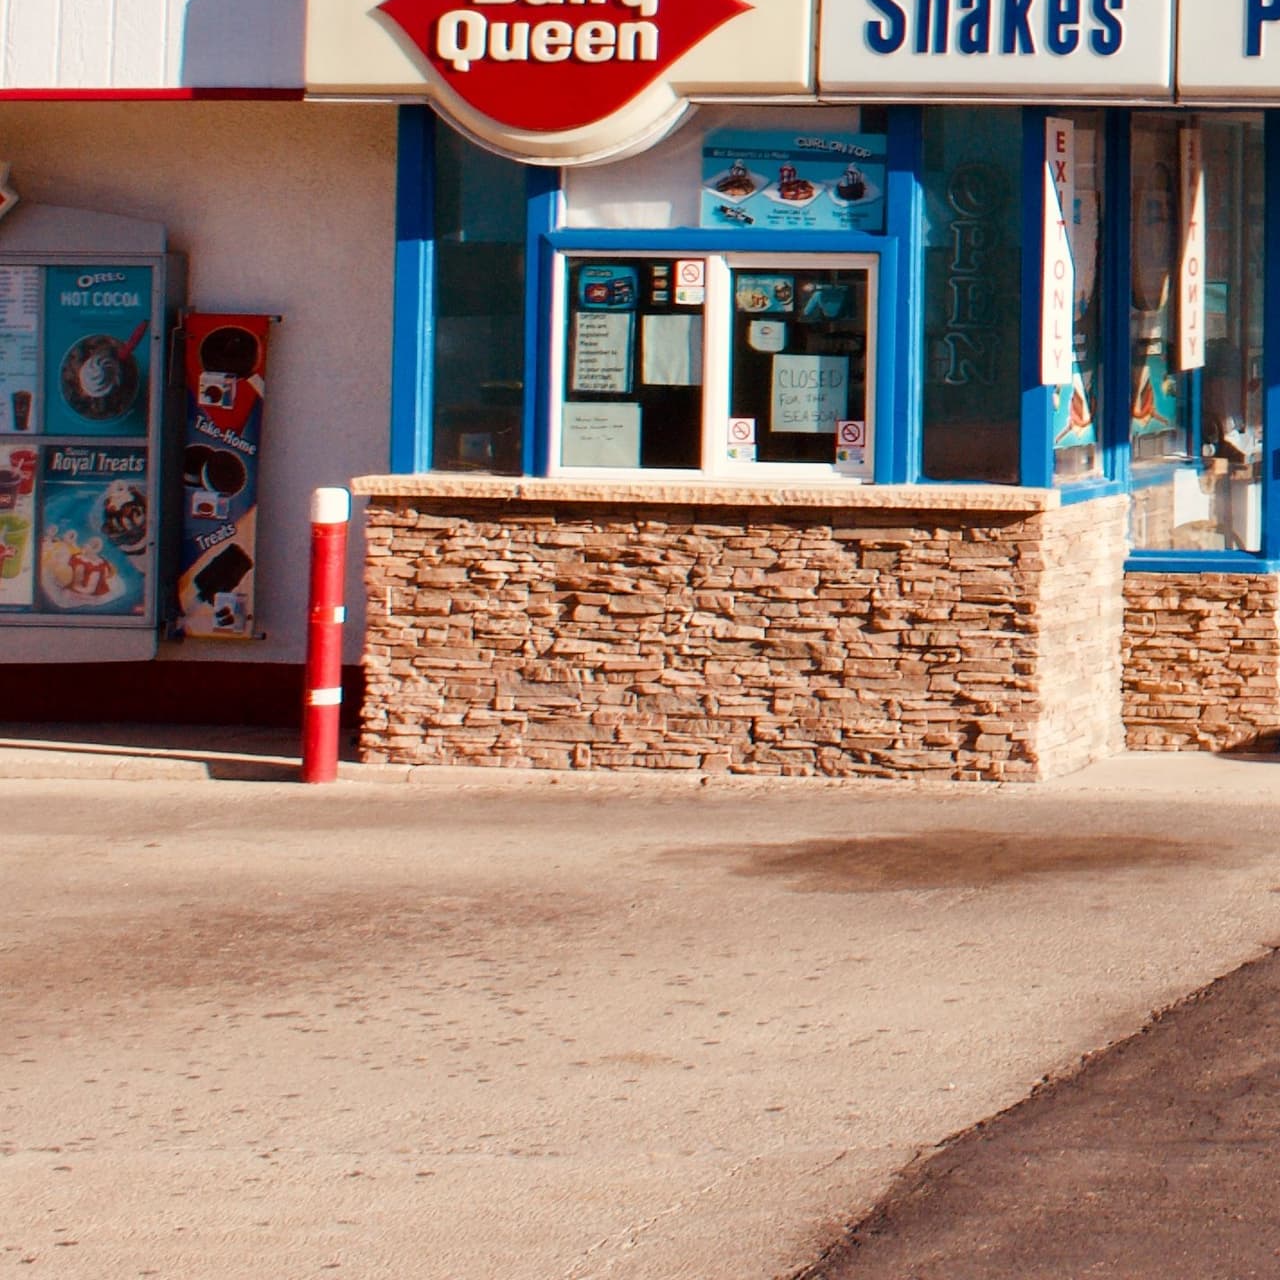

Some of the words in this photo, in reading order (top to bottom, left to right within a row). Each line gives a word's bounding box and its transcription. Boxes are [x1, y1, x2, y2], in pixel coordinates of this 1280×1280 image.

[436, 9, 660, 72] Queen
[1055, 130, 1067, 242] EXIT
[60, 291, 89, 306] HOT
[92, 291, 140, 307] COCOA
[1053, 259, 1066, 370] ONLY
[777, 369, 844, 389] CLOSED
[195, 415, 257, 455] Take-Home
[52, 451, 95, 476] Royal
[99, 453, 145, 472] Treats
[195, 523, 236, 551] Treats
